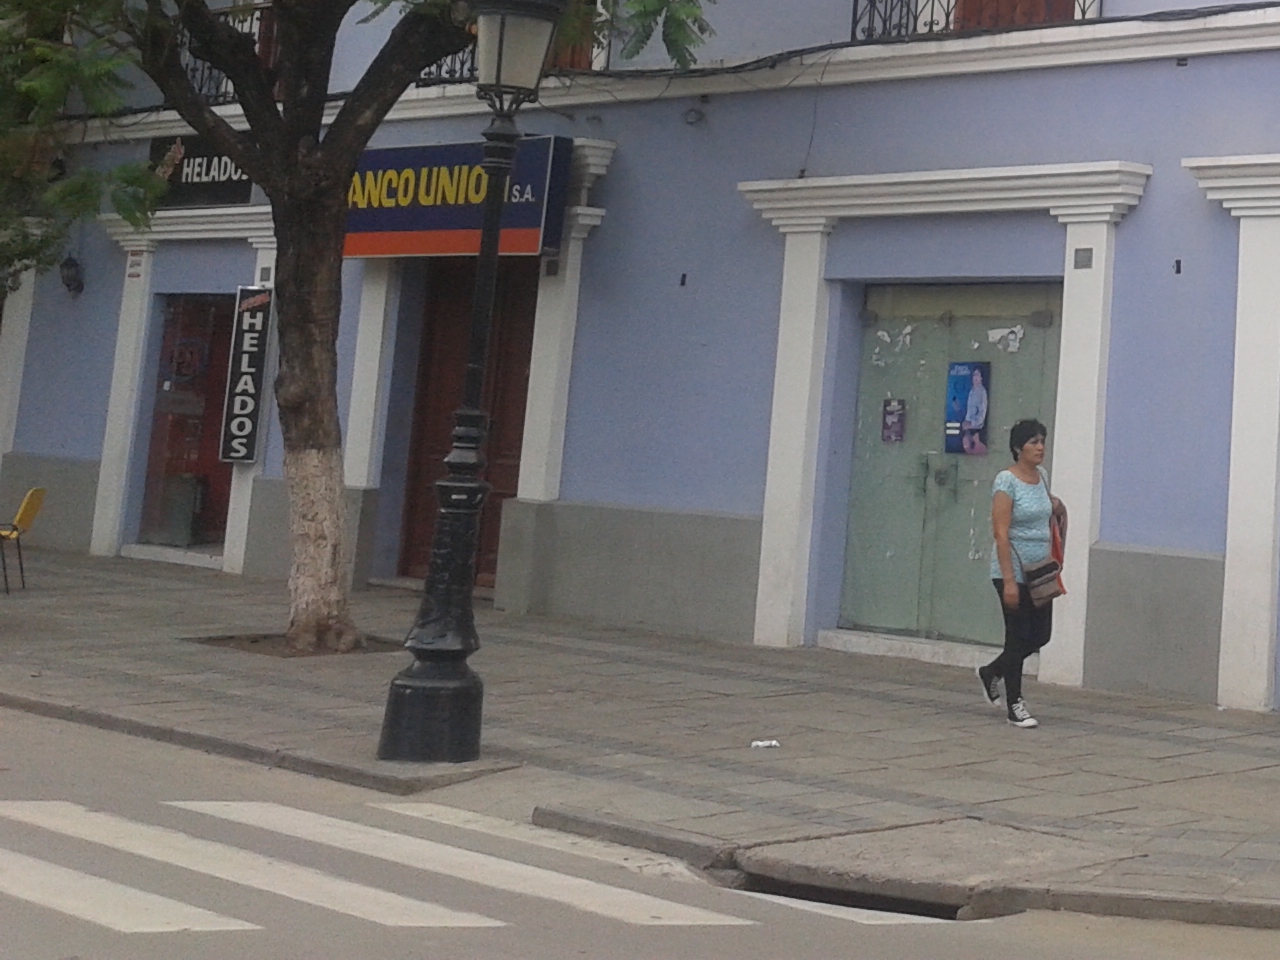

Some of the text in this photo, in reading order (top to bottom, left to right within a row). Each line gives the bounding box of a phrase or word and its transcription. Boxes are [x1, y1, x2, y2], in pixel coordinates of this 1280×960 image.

[182, 155, 249, 183] HELADO
[348, 166, 416, 209] ANCO
[511, 183, 536, 204] S.A.
[229, 311, 264, 458] HELADOS
